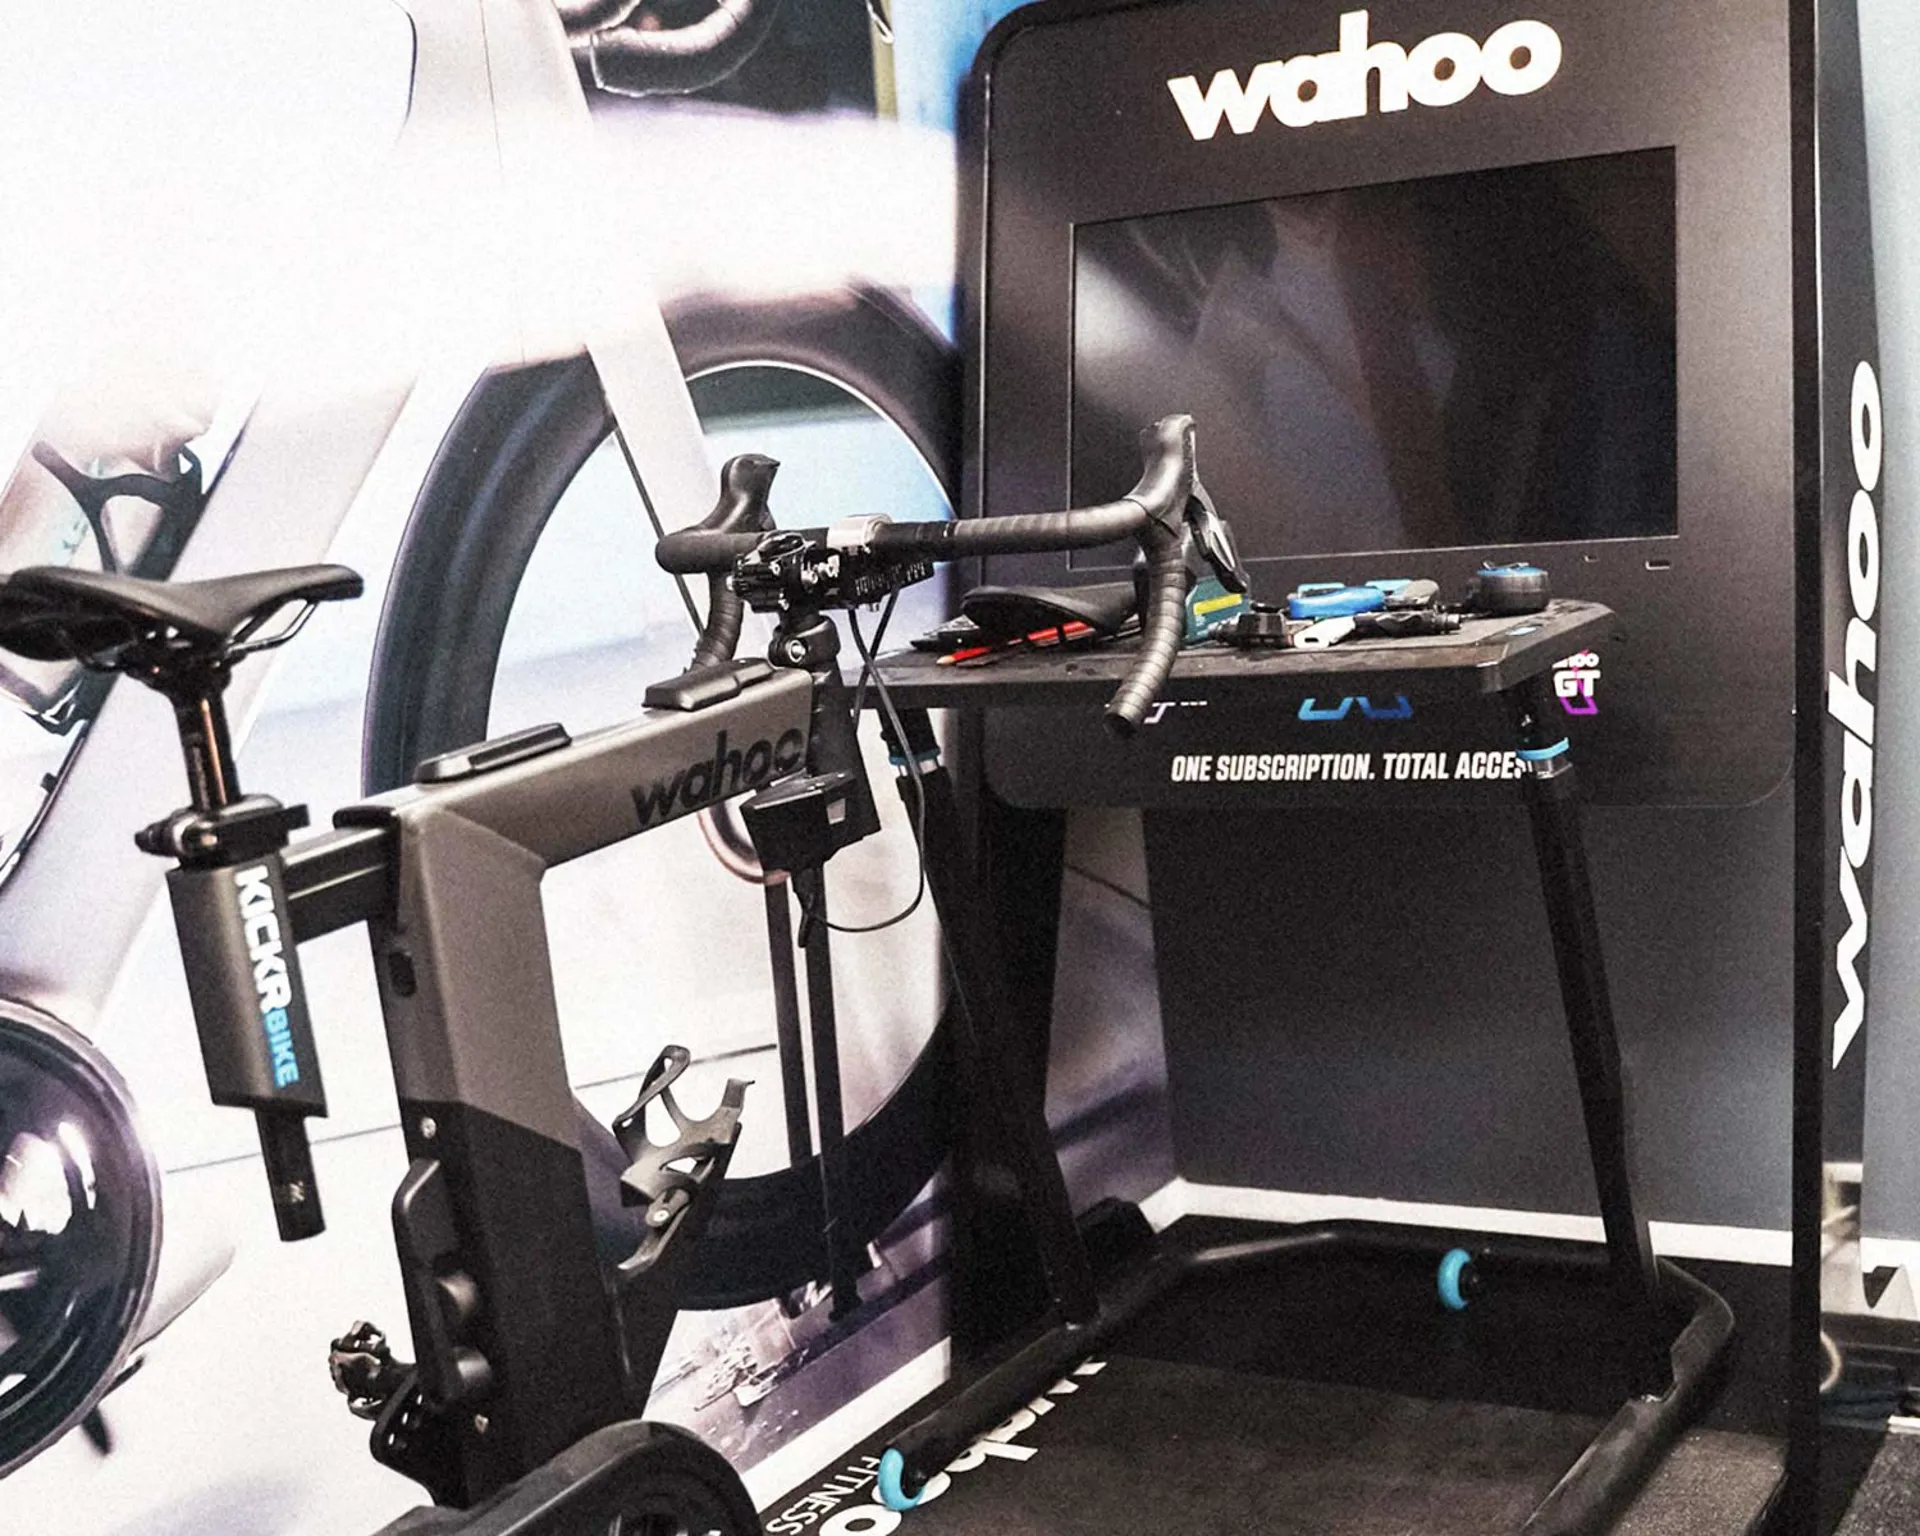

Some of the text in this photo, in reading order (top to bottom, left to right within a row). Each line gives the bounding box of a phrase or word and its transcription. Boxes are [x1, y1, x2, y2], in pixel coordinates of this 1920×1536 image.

[1167, 10, 1562, 140] wahoo
[1171, 755, 1213, 782] ONE
[1215, 753, 1375, 781] SUBSCRIPTION.
[1383, 752, 1449, 780] TOTAL
[1828, 360, 1883, 1070] wahoo
[631, 728, 804, 824] wahoo
